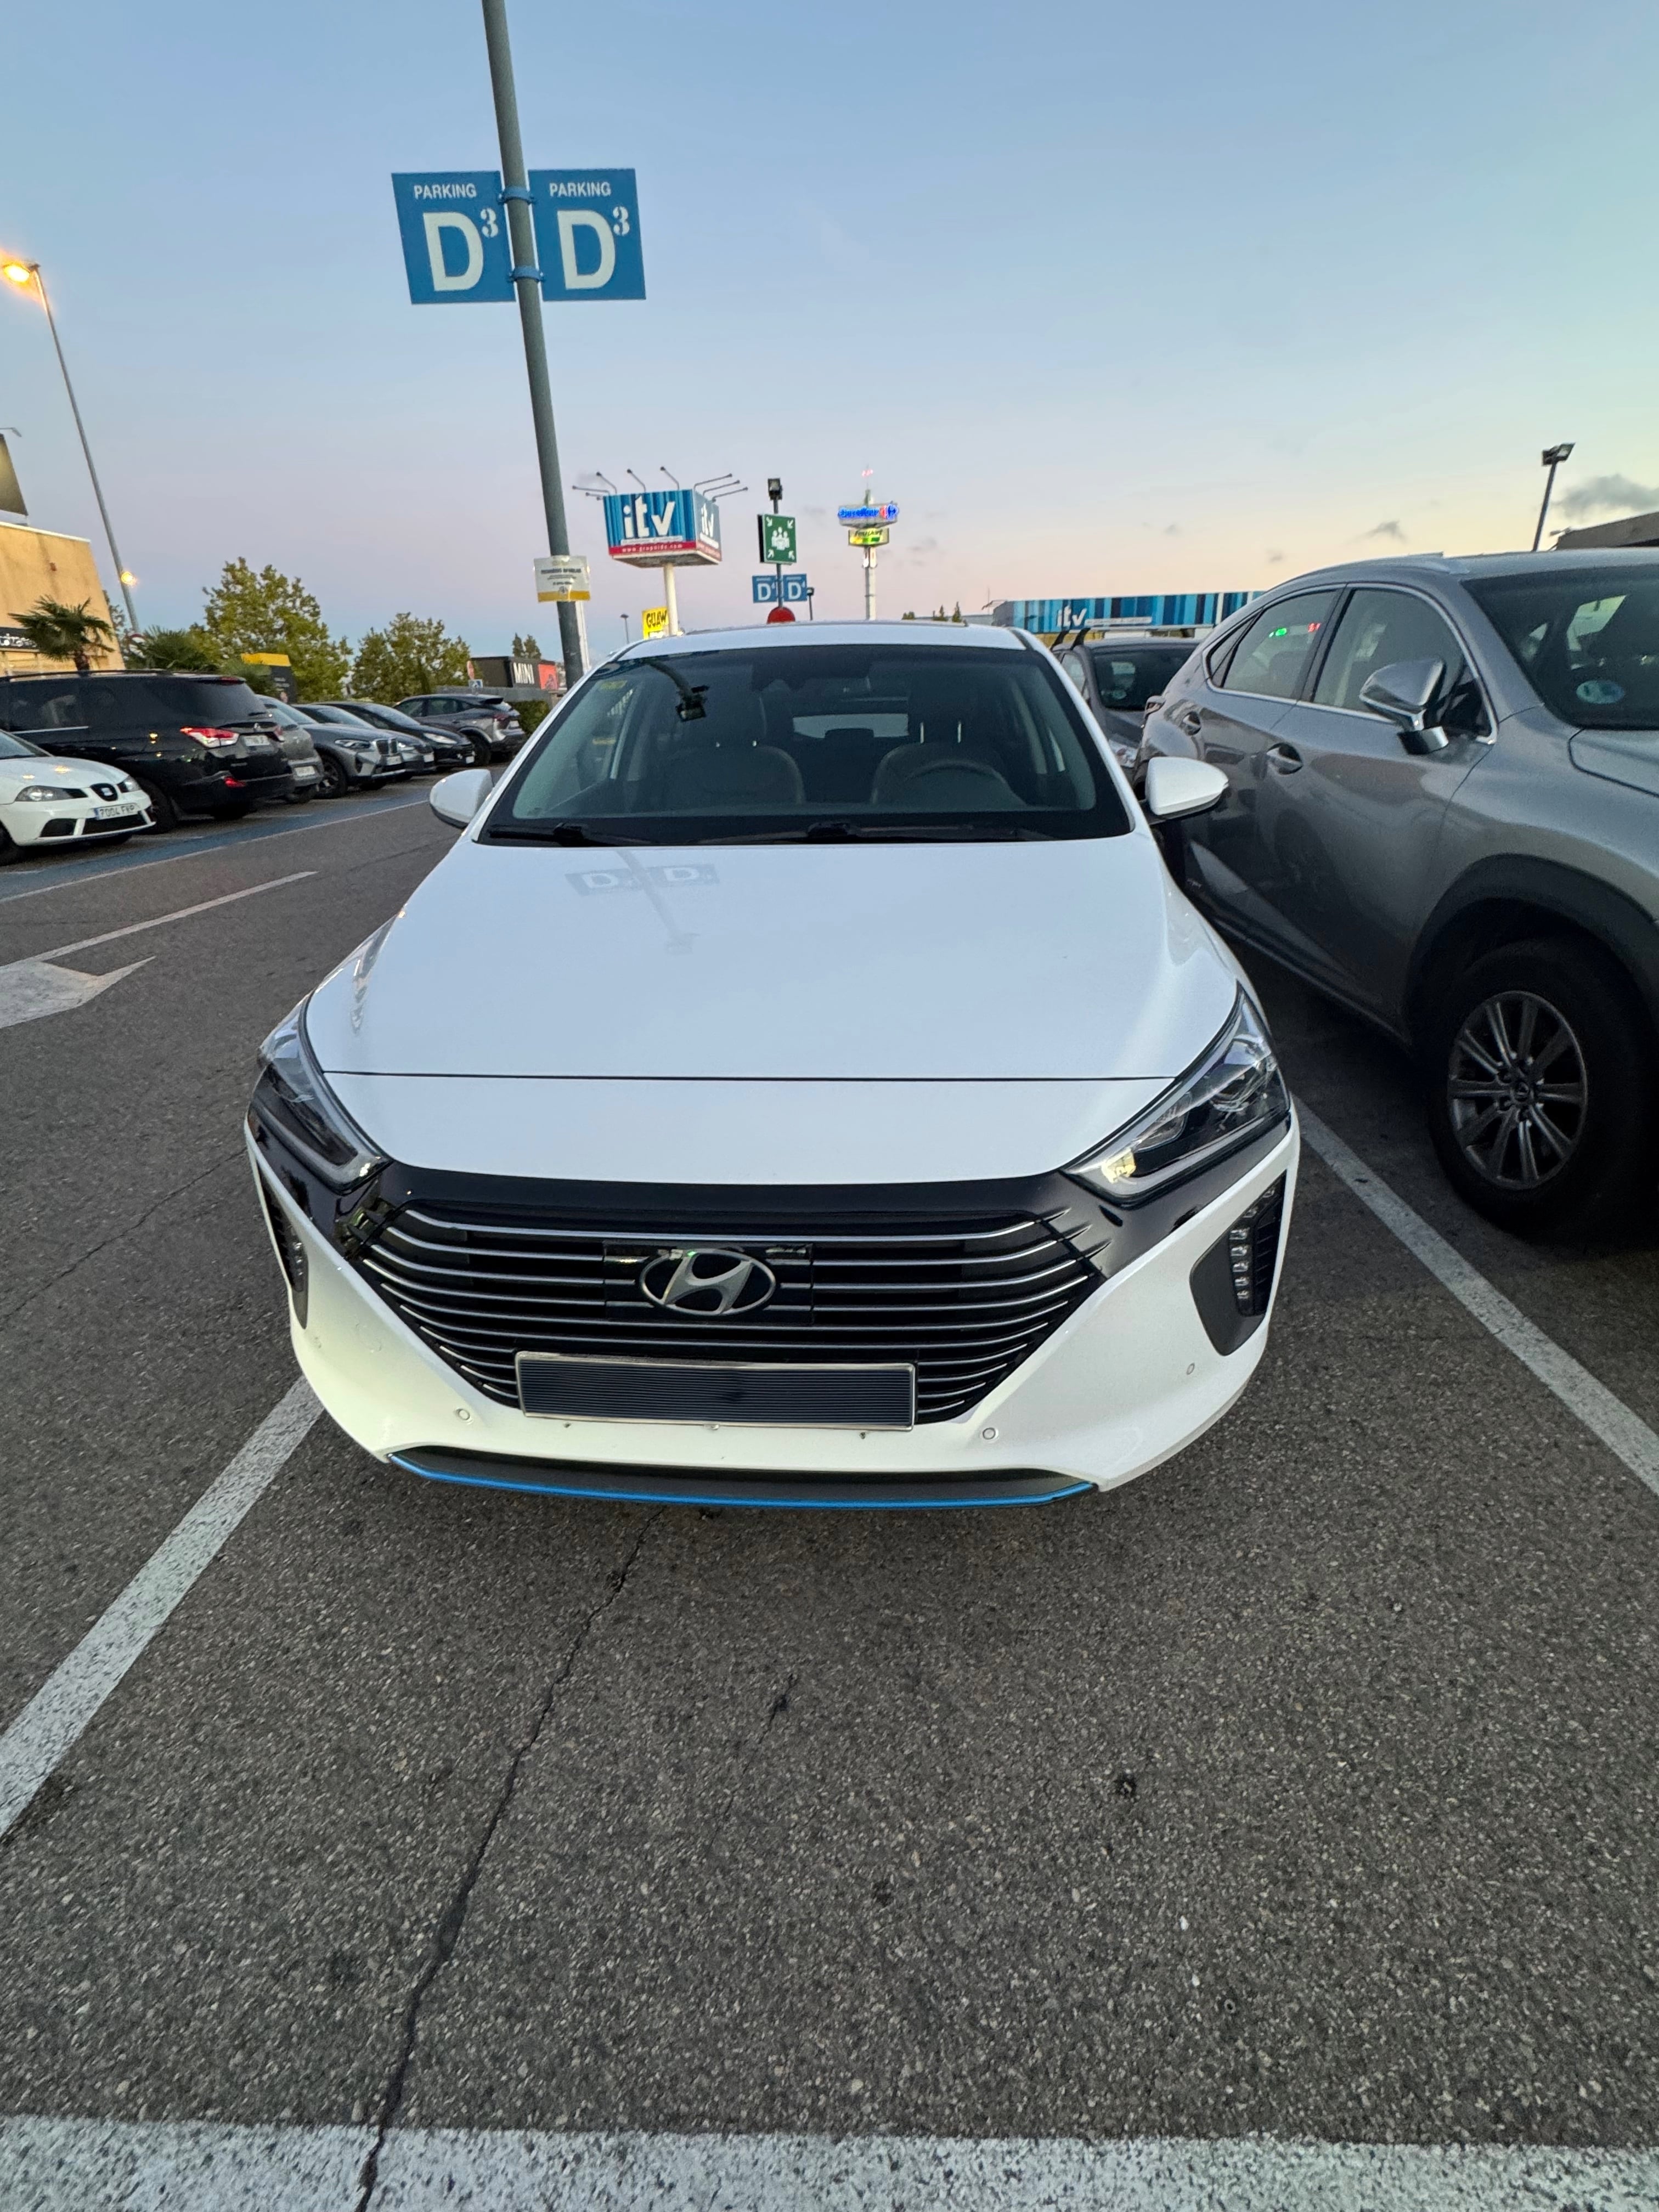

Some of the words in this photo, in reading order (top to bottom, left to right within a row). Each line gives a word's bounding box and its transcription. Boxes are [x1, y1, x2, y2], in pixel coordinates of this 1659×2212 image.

[414, 183, 477, 199] PARKING
[550, 182, 611, 197] PARKING
[623, 495, 675, 538] itv
[1057, 605, 1087, 627] itv
[513, 662, 535, 685] MINI
